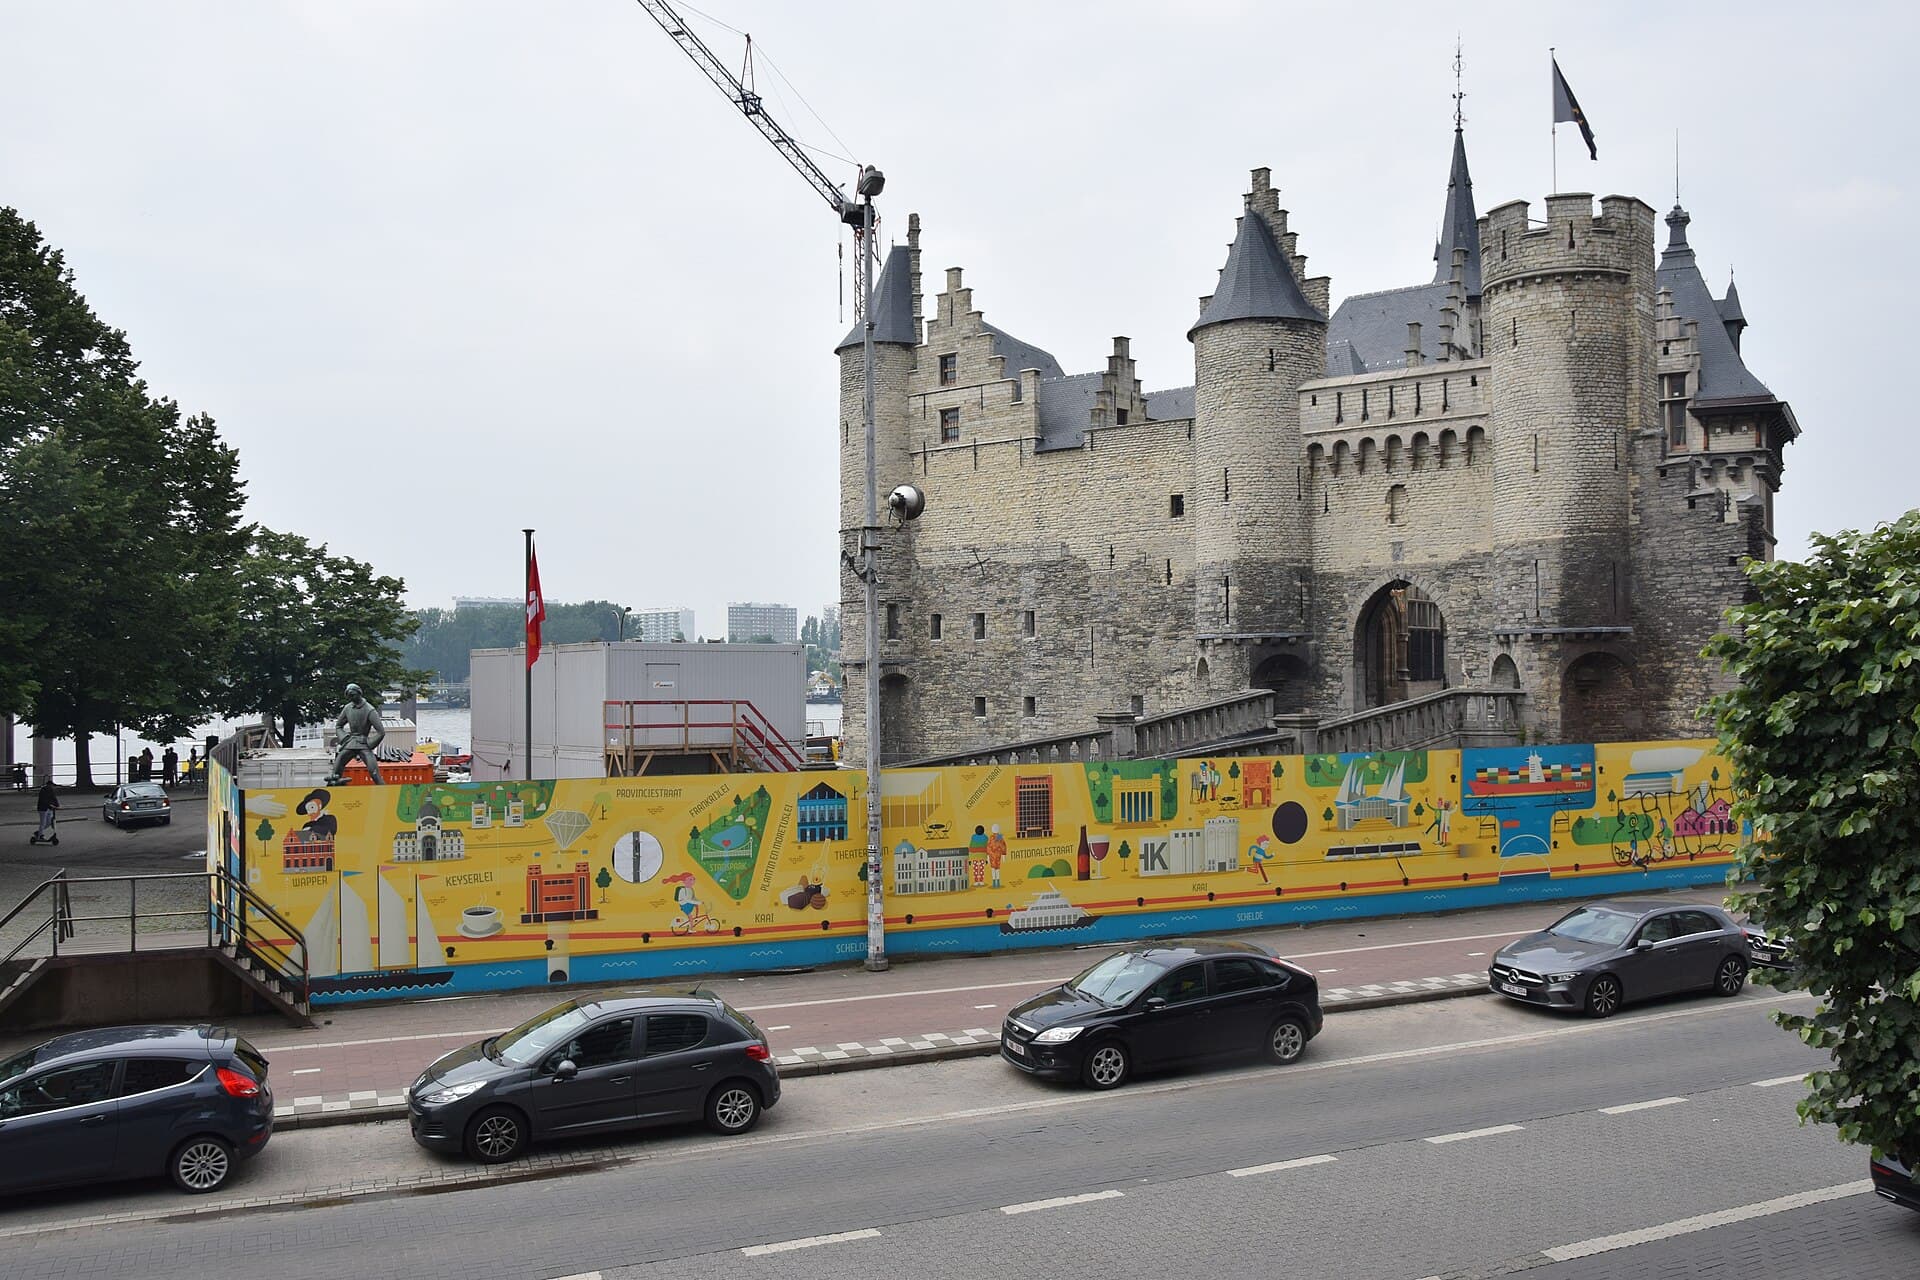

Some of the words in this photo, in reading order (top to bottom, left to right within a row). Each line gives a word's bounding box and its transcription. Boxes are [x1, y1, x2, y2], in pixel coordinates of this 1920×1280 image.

[616, 788, 682, 798] PROVINCIESTRAAT
[773, 804, 793, 851] MORETUSLEI
[769, 851, 779, 861] EN
[1010, 844, 1074, 860] NATIONALESTRAAT
[292, 875, 328, 888] WAPPER
[445, 871, 494, 887] KEYSERLEI
[760, 860, 777, 892] PLANTIN
[1192, 883, 1208, 892] KAAI
[754, 913, 774, 923] KAAI
[1236, 911, 1264, 922] SCHELDE
